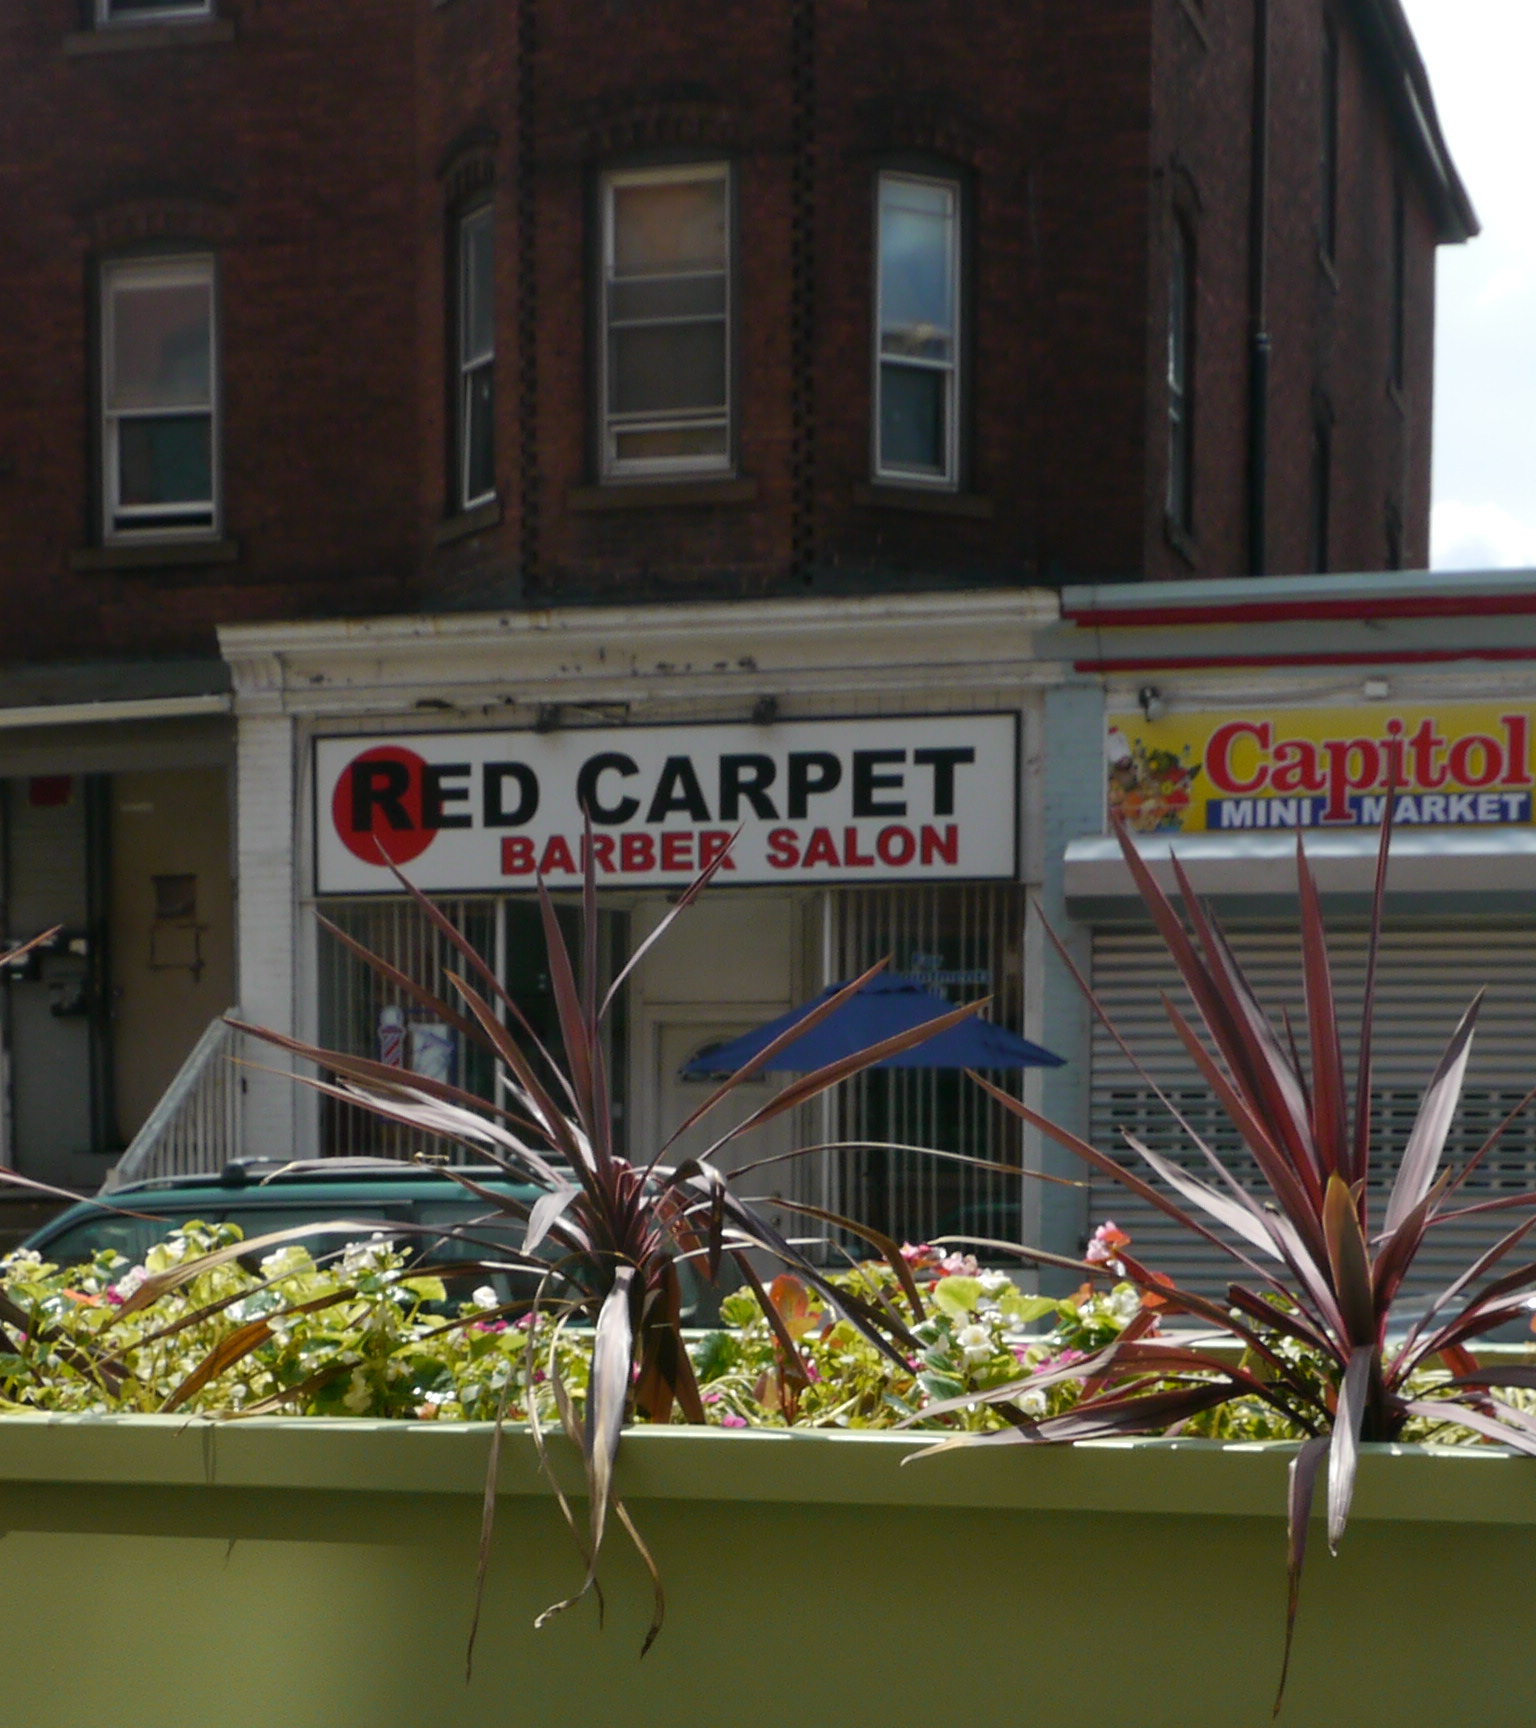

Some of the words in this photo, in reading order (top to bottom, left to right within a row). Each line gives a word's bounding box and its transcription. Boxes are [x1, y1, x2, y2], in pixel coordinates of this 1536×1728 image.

[353, 759, 539, 831] RED
[576, 747, 975, 825] CARPET
[1205, 715, 1532, 821] Capitol
[1220, 798, 1312, 827] MINI
[1362, 792, 1527, 824] MARKET
[501, 830, 734, 875] BARBER
[767, 824, 959, 868] SALON
